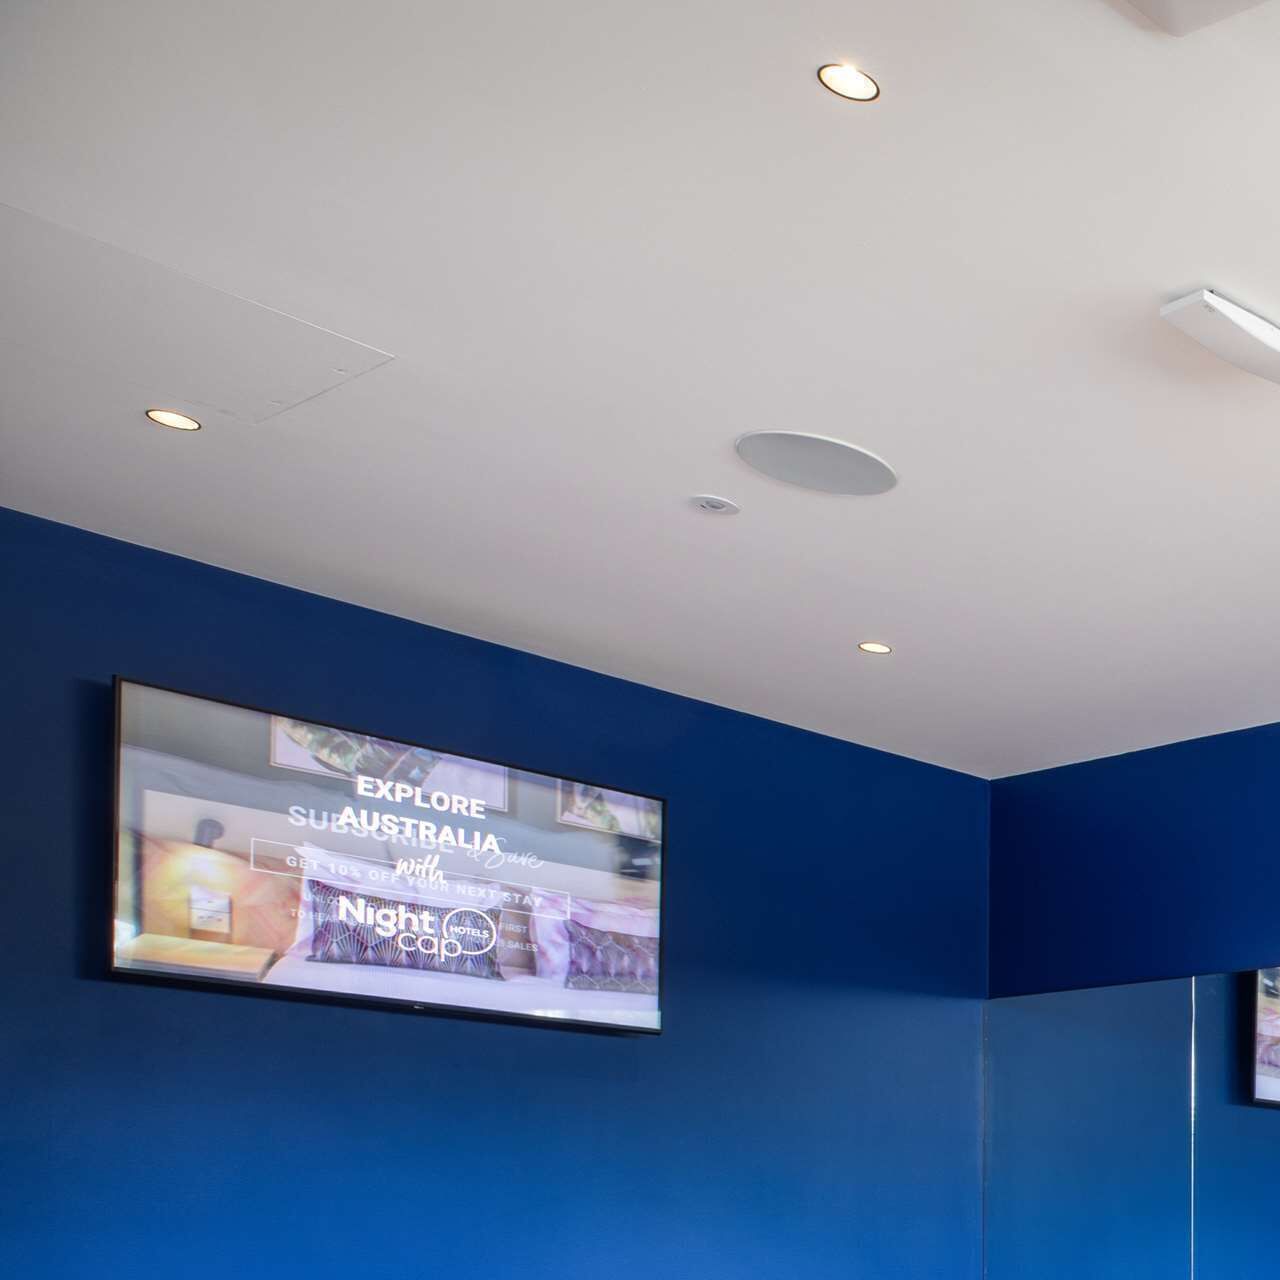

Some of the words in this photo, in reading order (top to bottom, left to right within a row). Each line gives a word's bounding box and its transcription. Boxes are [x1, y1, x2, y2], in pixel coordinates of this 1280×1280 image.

[357, 774, 486, 819] EXPLORE
[338, 806, 502, 855] AUSTRALIA
[396, 854, 447, 884] with
[484, 837, 545, 870] Save
[286, 855, 320, 871] GET
[329, 862, 361, 879] 10%
[369, 869, 404, 884] OFF
[407, 876, 450, 893] YOUR
[456, 885, 497, 900] NEXT
[503, 894, 544, 908] STAY
[338, 895, 435, 936] Night
[449, 925, 490, 938] HOTELS
[398, 931, 462, 962] cap
